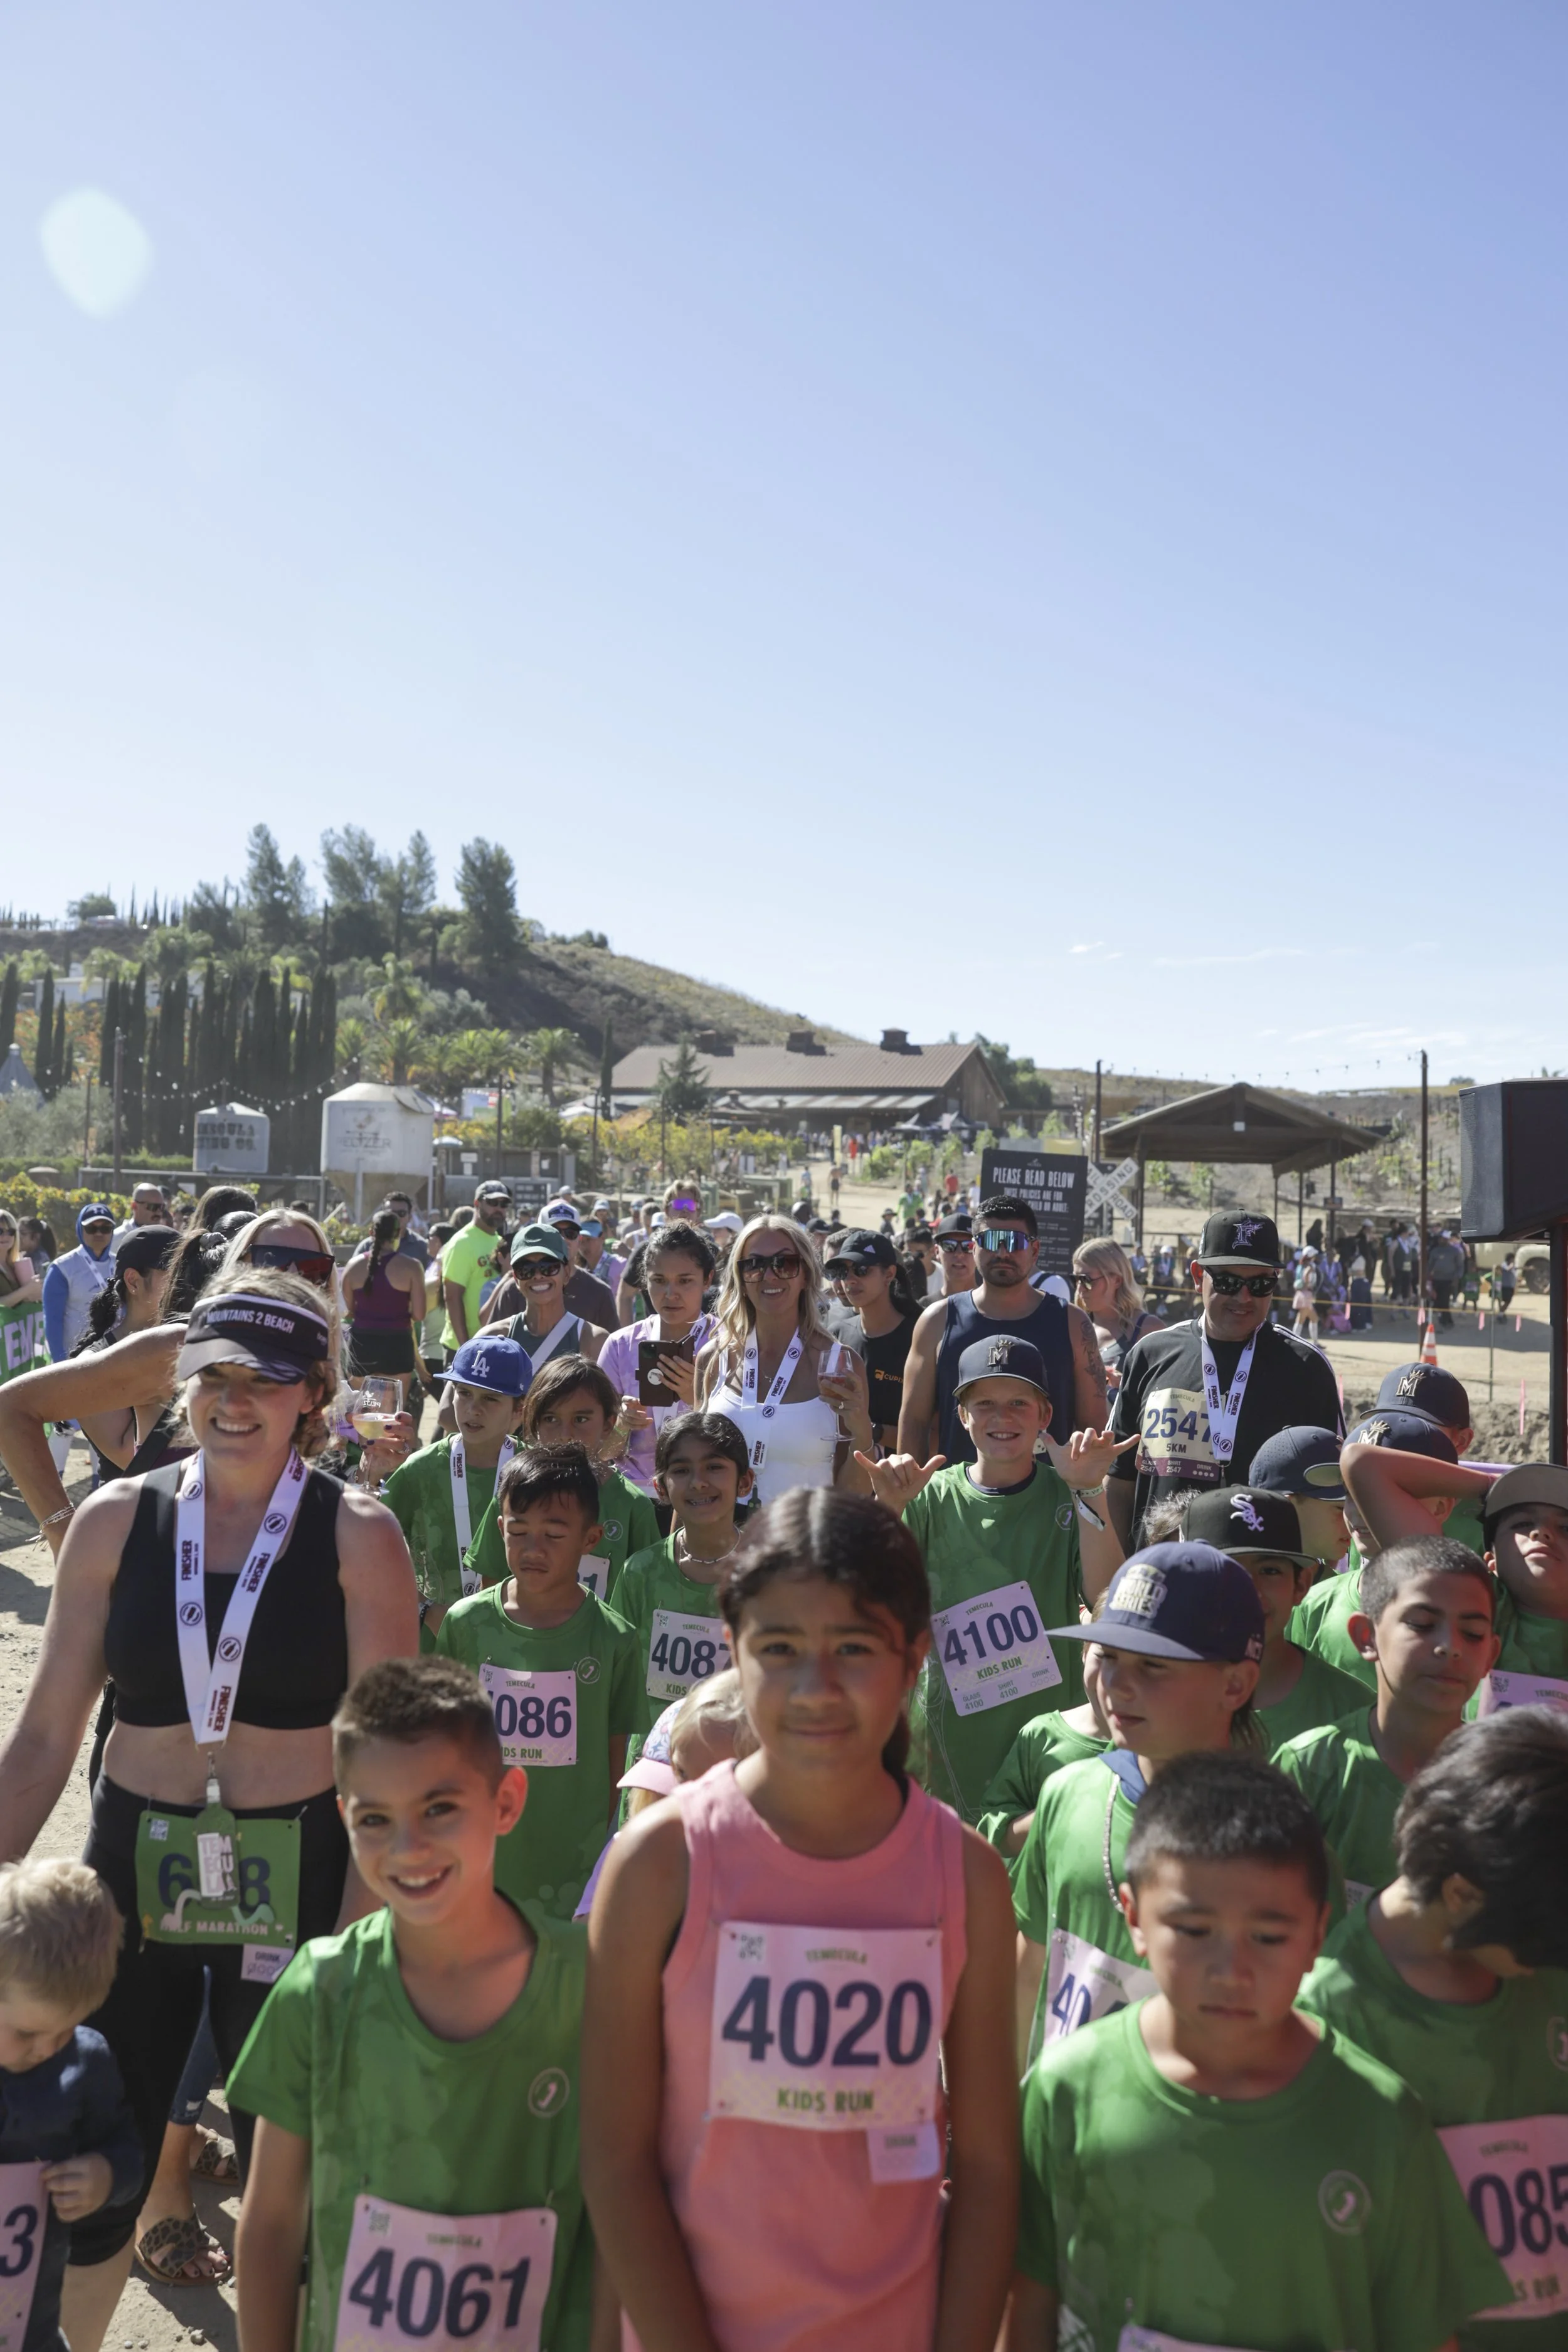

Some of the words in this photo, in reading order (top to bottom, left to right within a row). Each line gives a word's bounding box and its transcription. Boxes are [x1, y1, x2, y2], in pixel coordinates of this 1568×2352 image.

[992, 1167, 1022, 1185] PLEASE
[1024, 1169, 1046, 1186] READ
[1047, 1171, 1075, 1189] BELOW
[1086, 1164, 1133, 1214] ROSSING
[206, 1309, 255, 1324] MOUNTAINS
[255, 1312, 263, 1325] 2
[263, 1314, 295, 1333] BEACH
[471, 1350, 490, 1378] LA
[771, 1377, 784, 1397] FINISHER
[1210, 1385, 1219, 1409] FINISHER
[1230, 1392, 1241, 1416] FINISHER
[1144, 1407, 1211, 1443] 2547
[753, 1440, 762, 1466] FINISHER
[1166, 1443, 1187, 1453] 5KM
[181, 1540, 193, 1581] FINISHER
[246, 1552, 270, 1592] FINISHER
[965, 1601, 993, 1616] TEMECULA
[682, 1624, 710, 1633] TEMECULA
[944, 1605, 1038, 1666] 4100
[651, 1633, 732, 1679] 4087
[977, 1665, 1000, 1680] KIDS
[1002, 1656, 1022, 1671] RUN
[506, 1680, 535, 1689] TEMECULA
[998, 1680, 1014, 1690] SHIRT
[1032, 1668, 1049, 1678] DRINK
[666, 1683, 687, 1695] KIDS
[962, 1692, 980, 1702] GLASS
[1000, 1687, 1019, 1698] 4100
[213, 1685, 231, 1732] FINISHER
[488, 1691, 572, 1739] 086
[965, 1699, 983, 1710] 4100
[502, 1747, 517, 1757] DS
[520, 1748, 543, 1759] RUN
[159, 1853, 271, 1913] 68
[196, 1920, 268, 1936] MARATHON
[255, 1951, 280, 1963] DRINK
[722, 1975, 932, 2067] 4020
[777, 2087, 826, 2112] KIDS
[834, 2089, 874, 2111] RUN
[1468, 2163, 1568, 2259] 085
[348, 2245, 531, 2339] 4061
